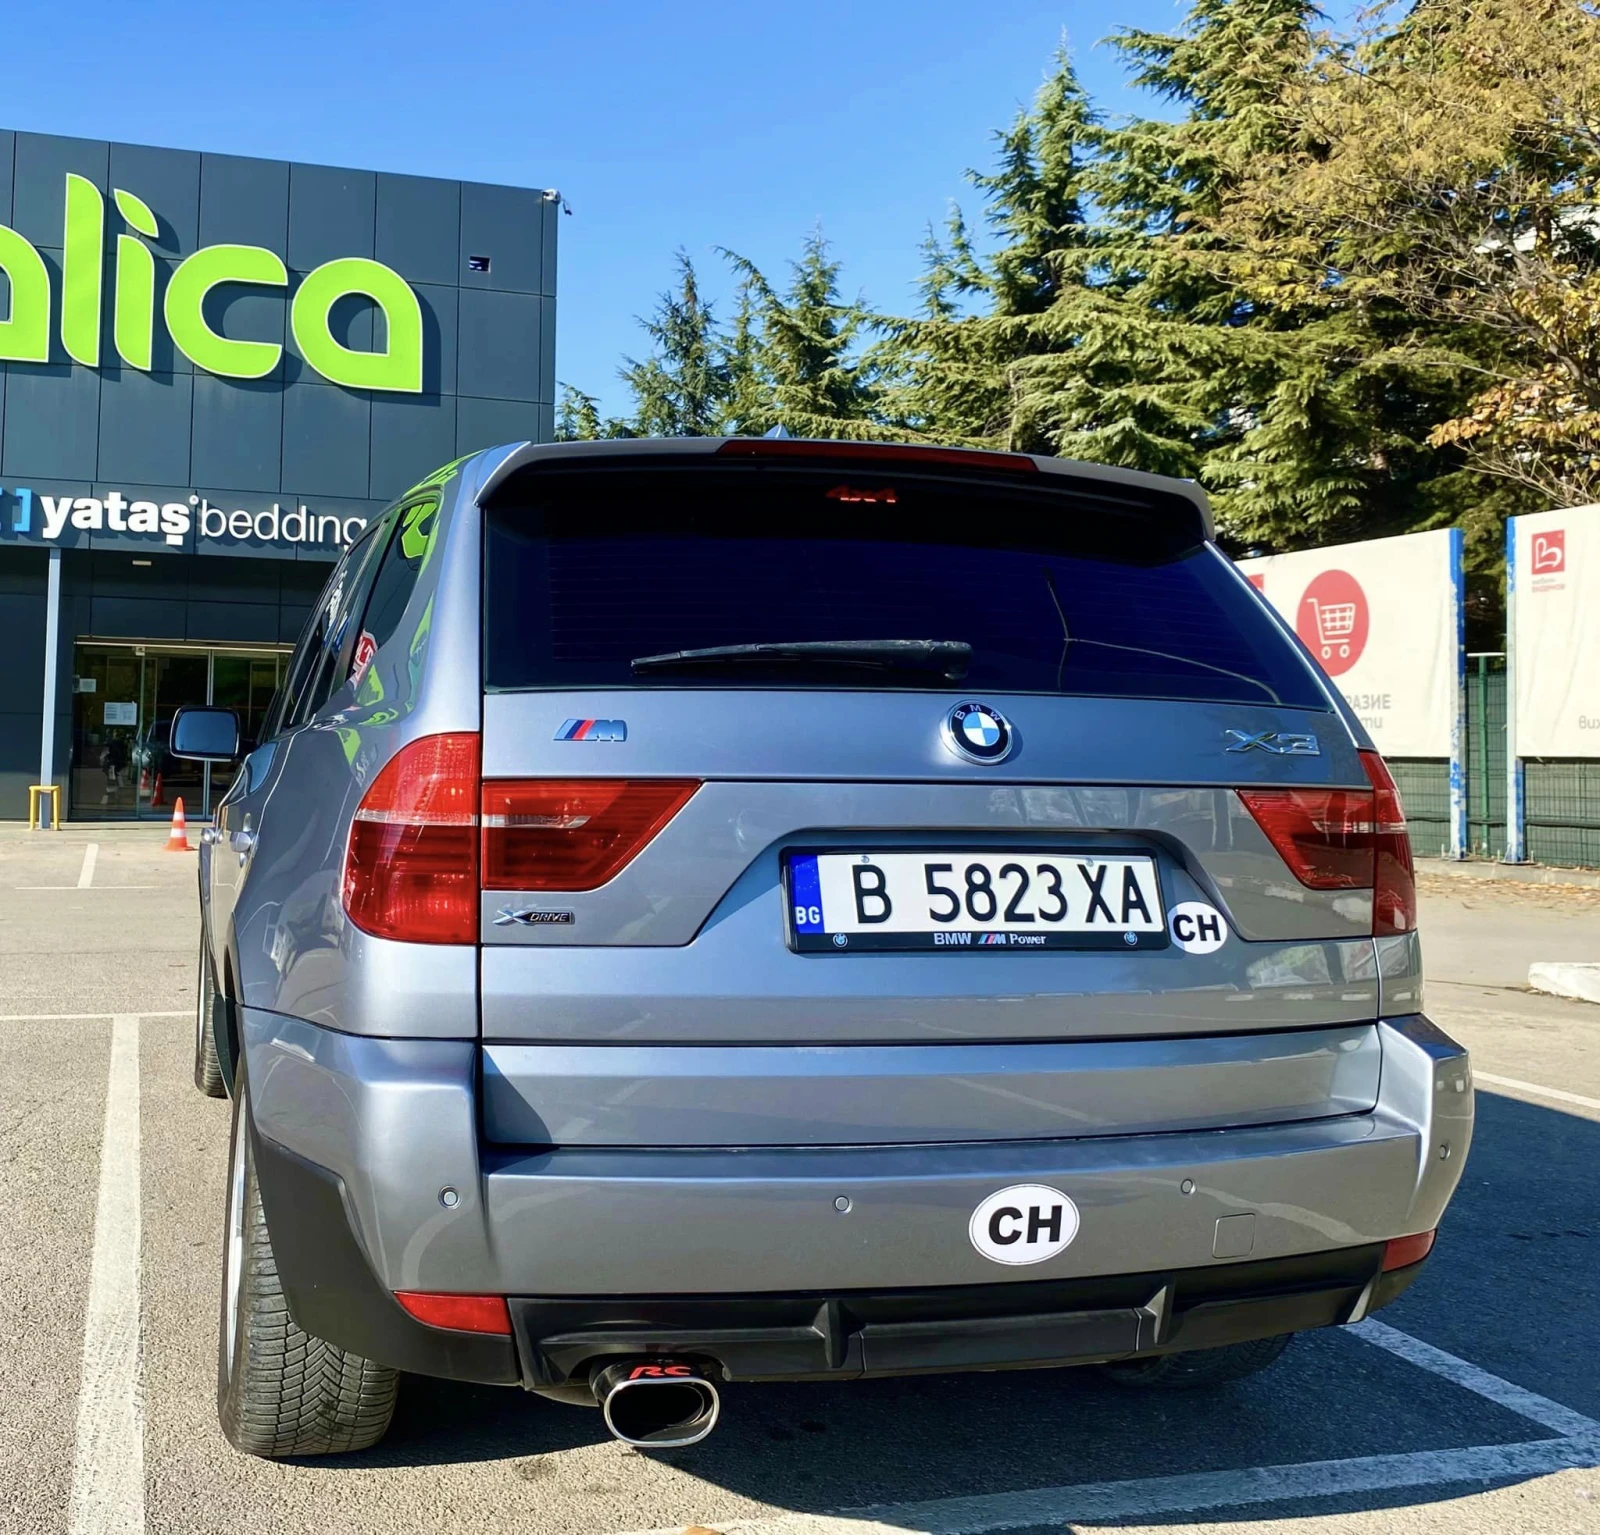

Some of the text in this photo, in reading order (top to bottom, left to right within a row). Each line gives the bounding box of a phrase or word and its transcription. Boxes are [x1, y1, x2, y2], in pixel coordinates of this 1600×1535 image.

[954, 704, 1001, 721] BMW
[1225, 729, 1320, 755] X3
[852, 863, 1152, 924] B 5823 XA
[795, 906, 820, 924] BG
[934, 932, 972, 945] BMW
[1009, 933, 1046, 945] Power
[1172, 913, 1222, 942] CH
[988, 1205, 1062, 1246] CH
[629, 1366, 691, 1379] RC
